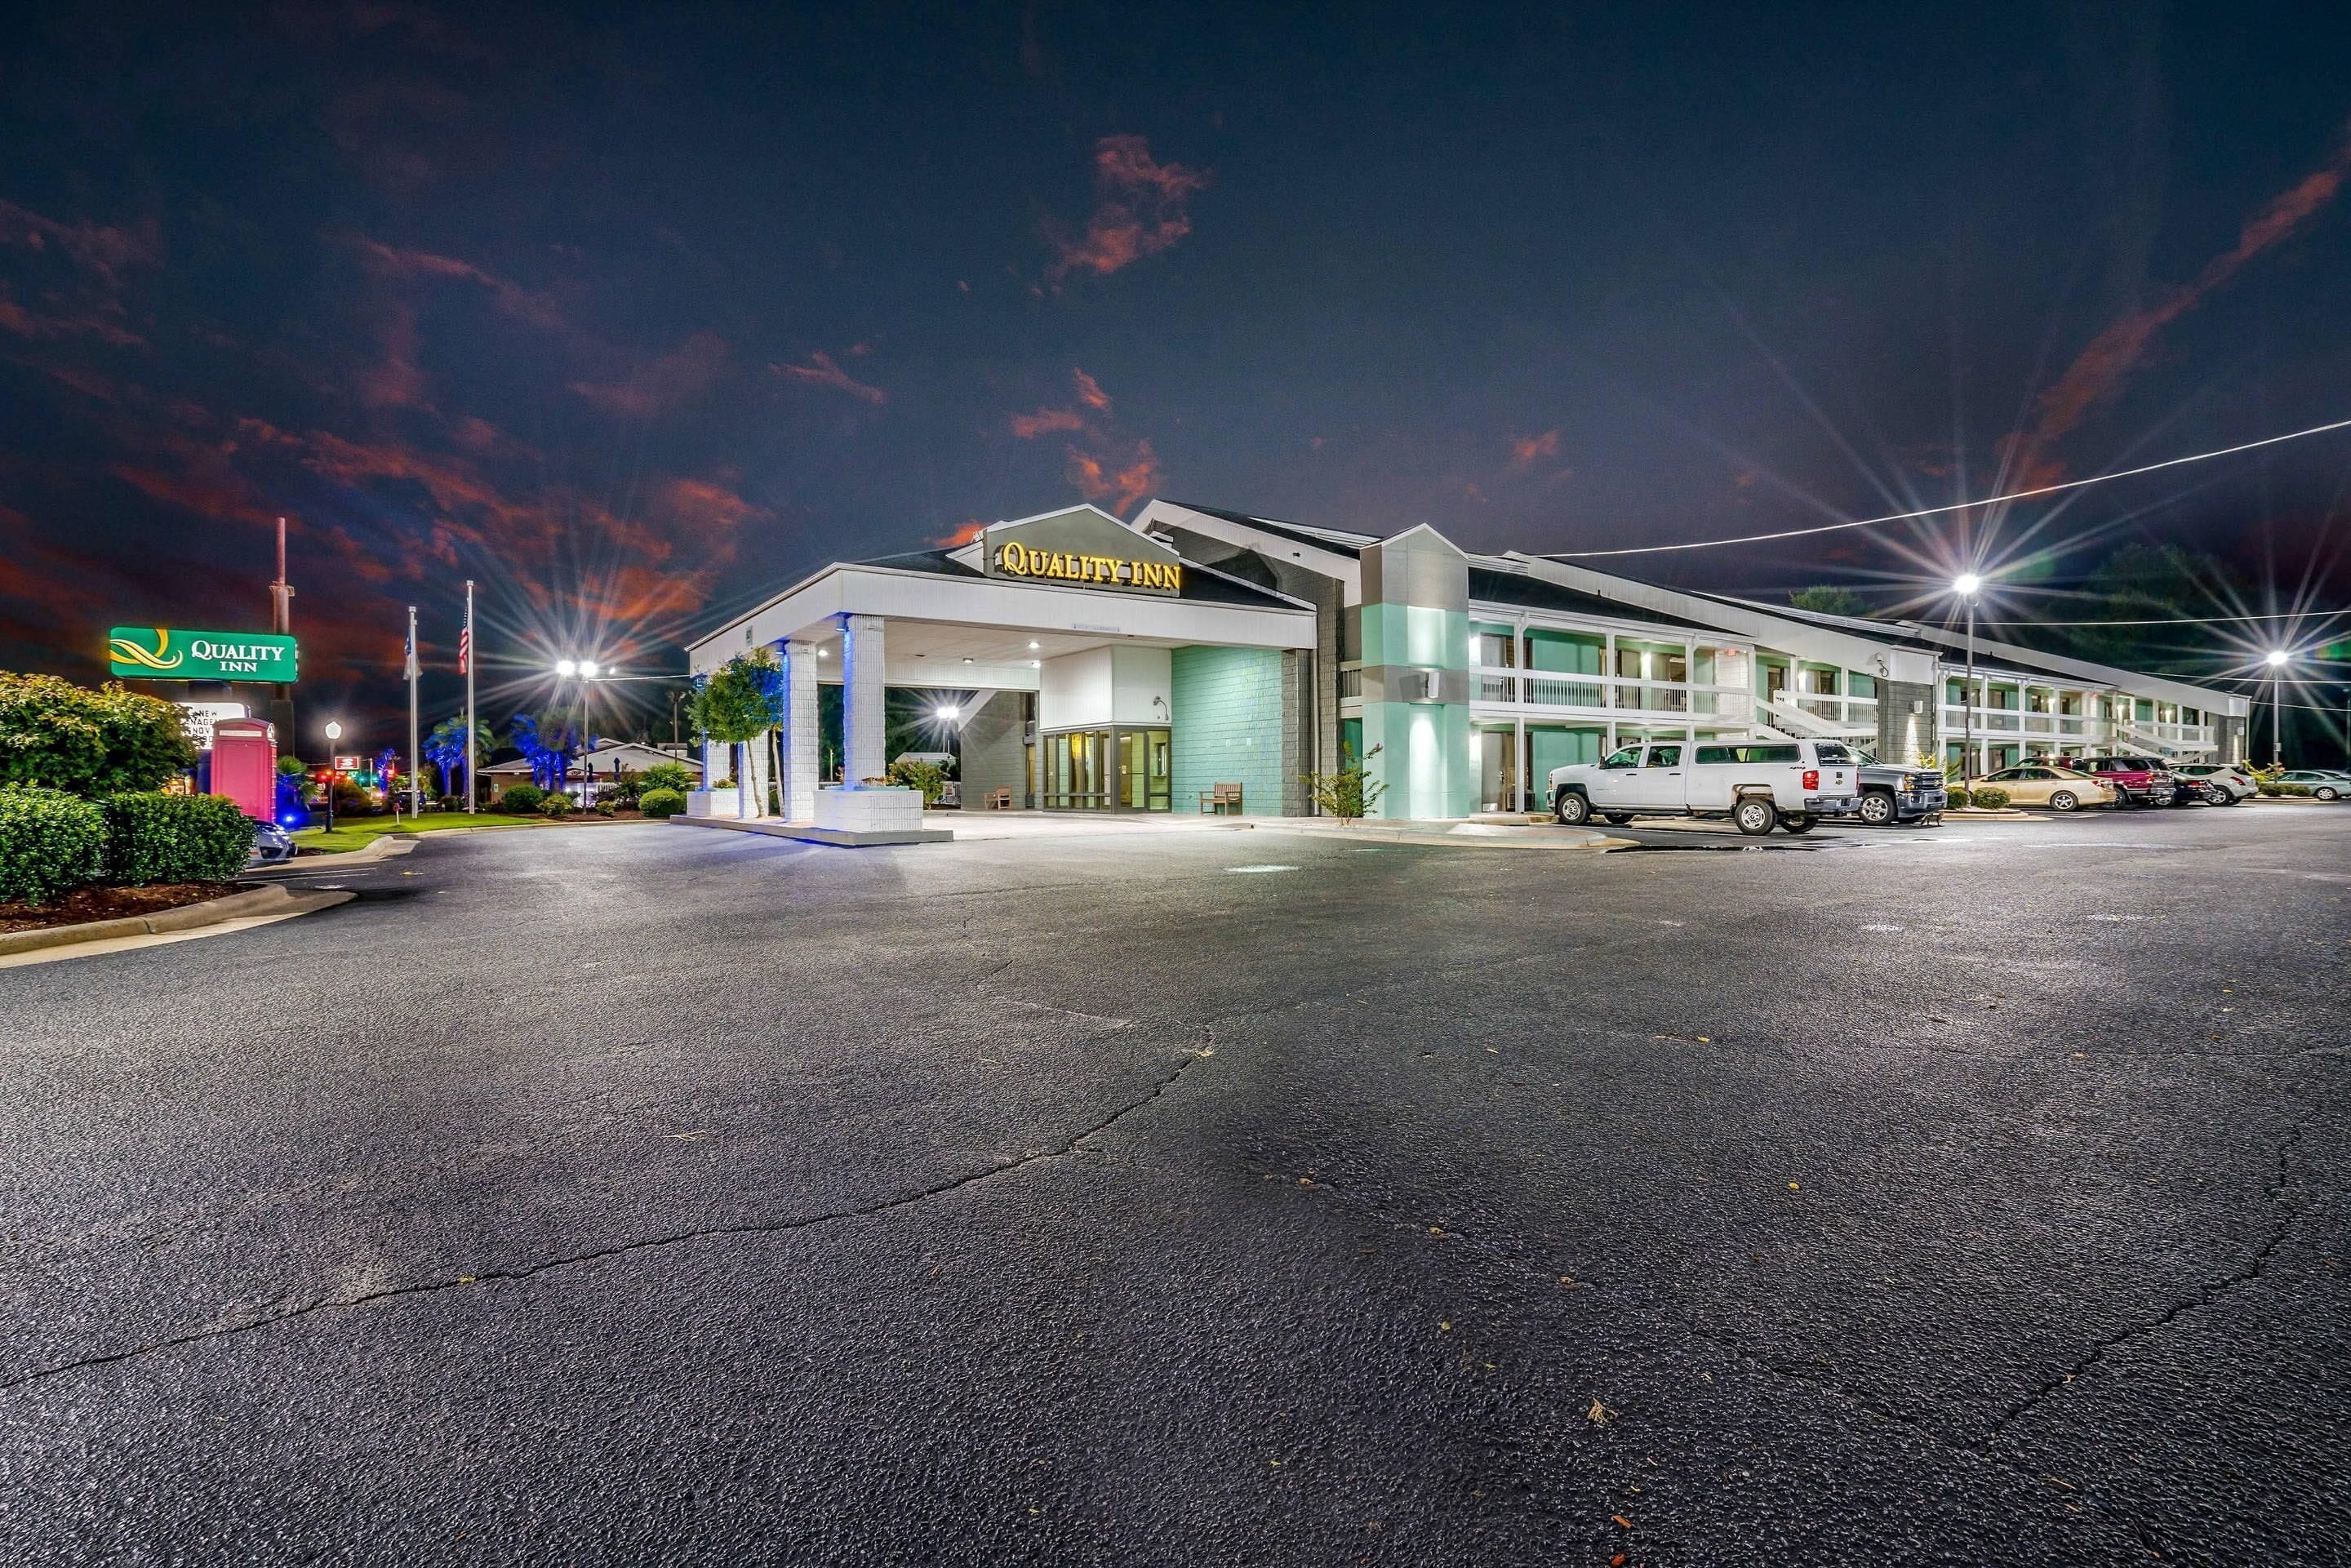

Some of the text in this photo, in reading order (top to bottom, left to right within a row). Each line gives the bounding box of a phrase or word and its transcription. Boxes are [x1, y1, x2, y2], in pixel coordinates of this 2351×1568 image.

[1001, 542, 1180, 589] QUALITY INN
[191, 640, 286, 661] QUALITY
[220, 661, 258, 673] INN
